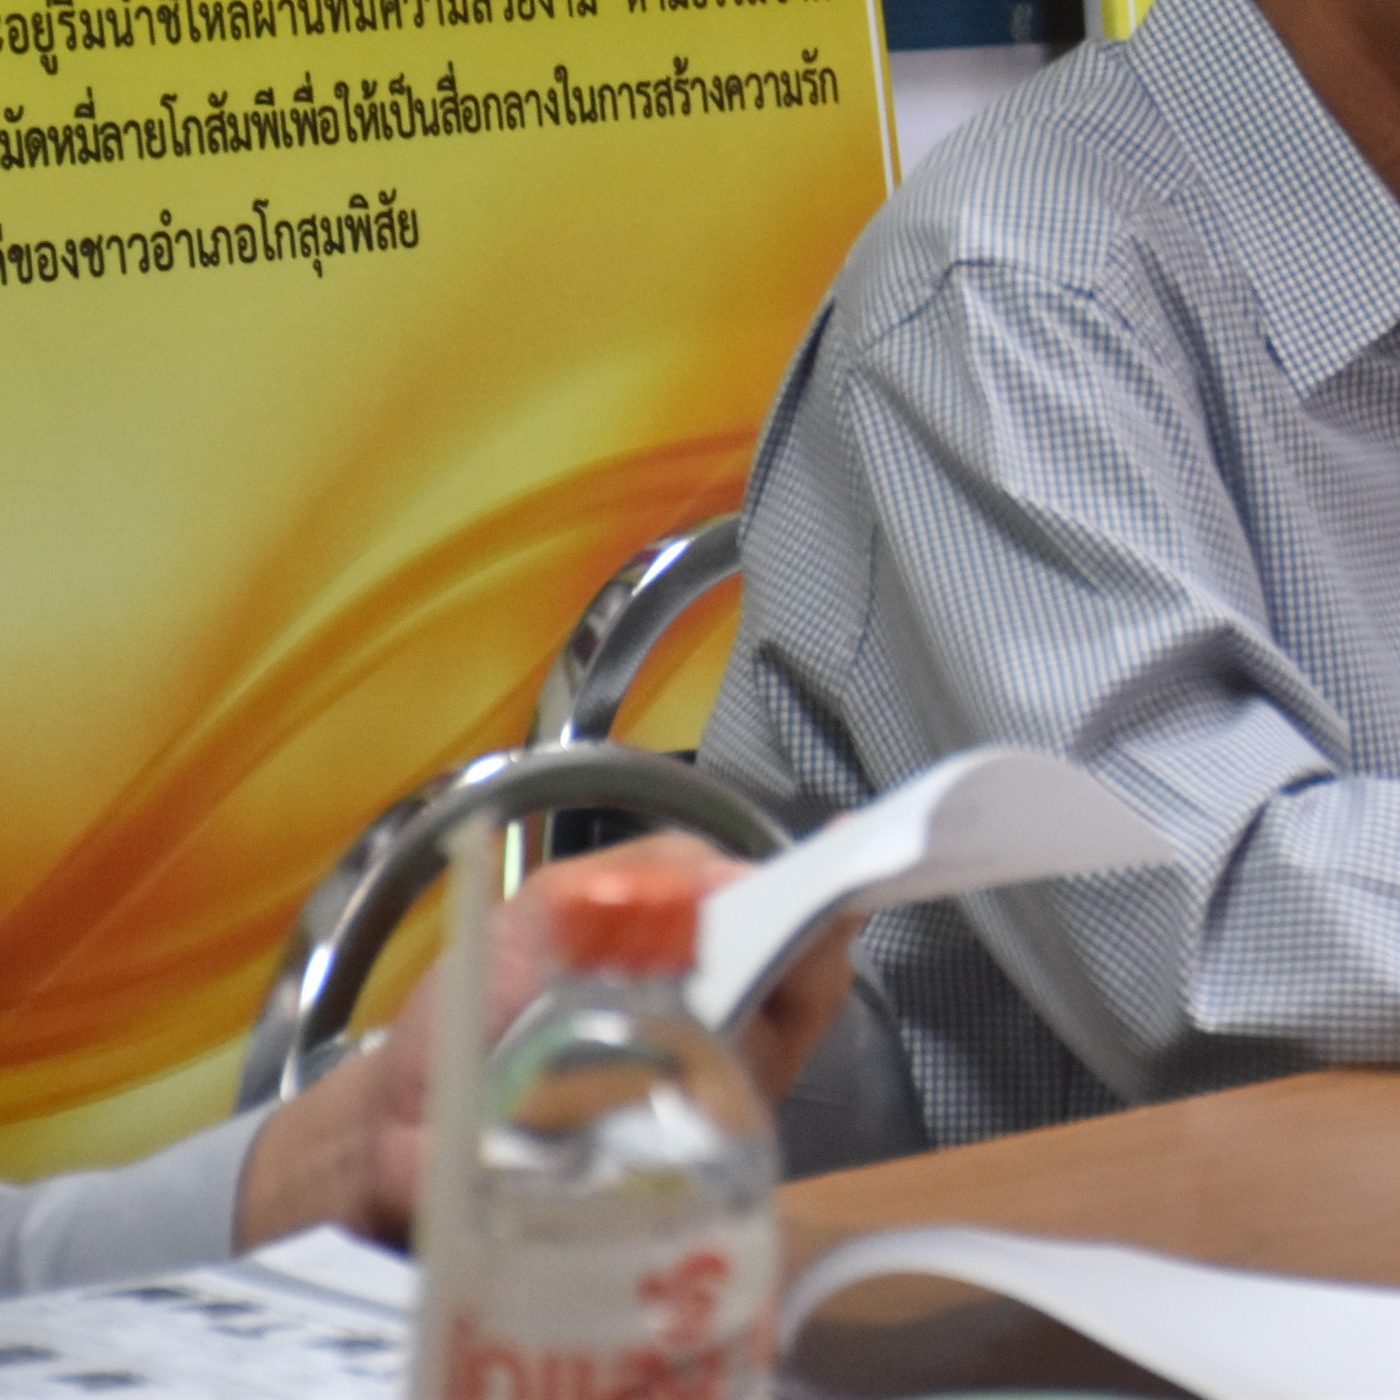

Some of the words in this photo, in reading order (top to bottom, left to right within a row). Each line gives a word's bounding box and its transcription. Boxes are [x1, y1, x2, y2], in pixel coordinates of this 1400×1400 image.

[0, 188, 420, 286] ของชาวอำเภอโกสุมพิสัย
